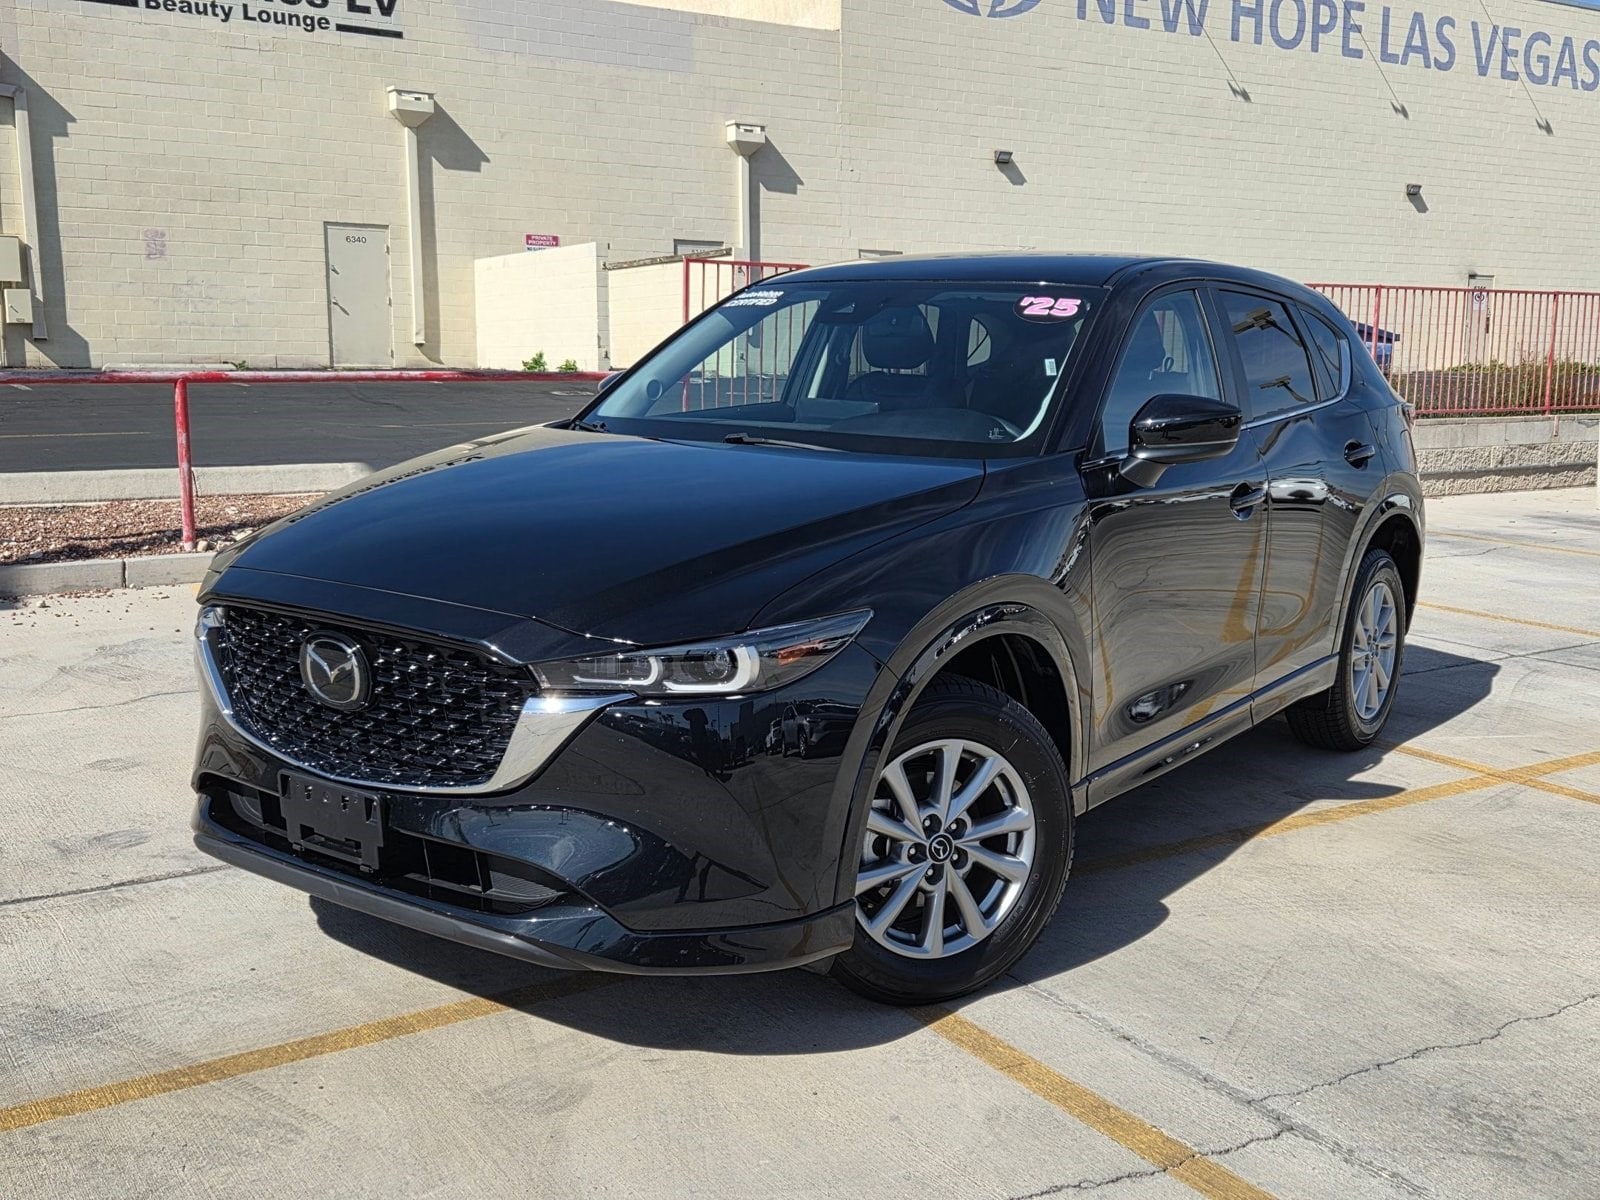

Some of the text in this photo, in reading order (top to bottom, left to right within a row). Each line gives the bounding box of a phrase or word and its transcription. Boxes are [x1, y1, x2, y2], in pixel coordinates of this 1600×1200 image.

[145, 0, 331, 32] Beauty Lounge
[1231, 0, 1365, 59] HOPE
[1380, 6, 1456, 71] LAS
[1471, 20, 1600, 92] VEGAS
[345, 235, 367, 244] 6340
[1020, 296, 1082, 316] '25
